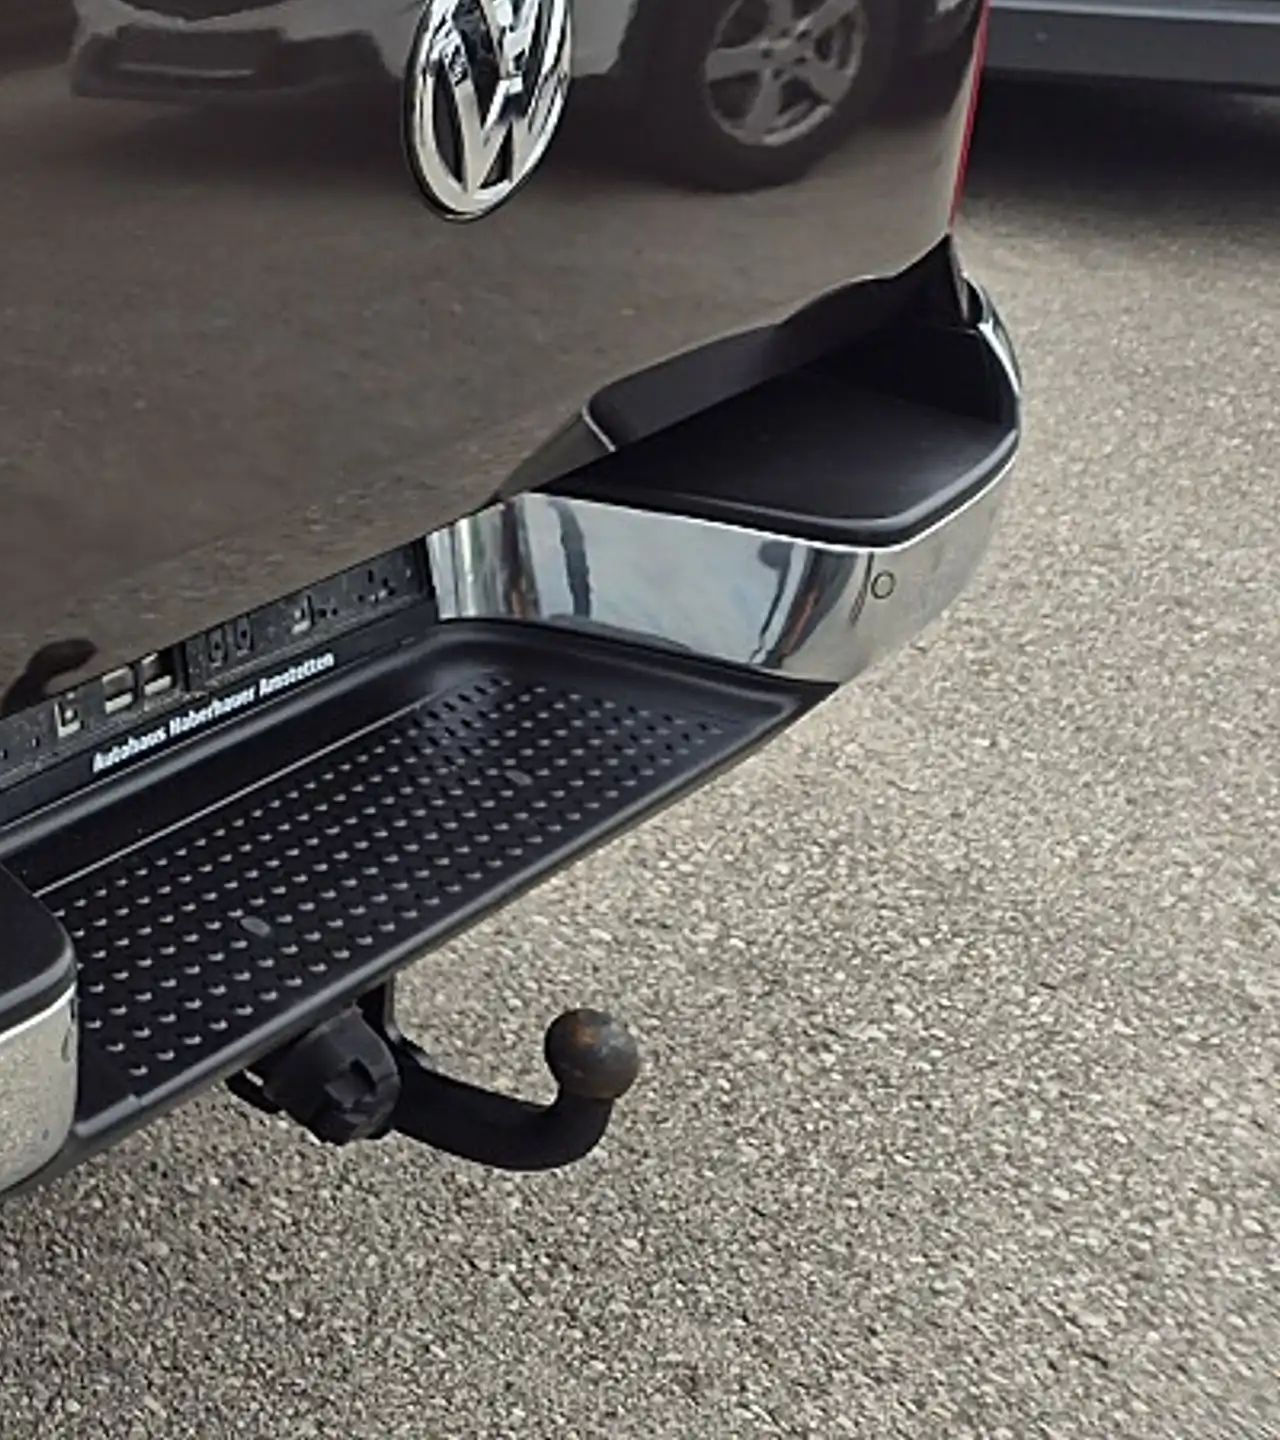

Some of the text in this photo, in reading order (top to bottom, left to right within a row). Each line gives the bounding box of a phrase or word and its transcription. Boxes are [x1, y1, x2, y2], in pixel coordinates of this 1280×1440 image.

[91, 651, 335, 774] Autohaus Haberhauer Amstetten
